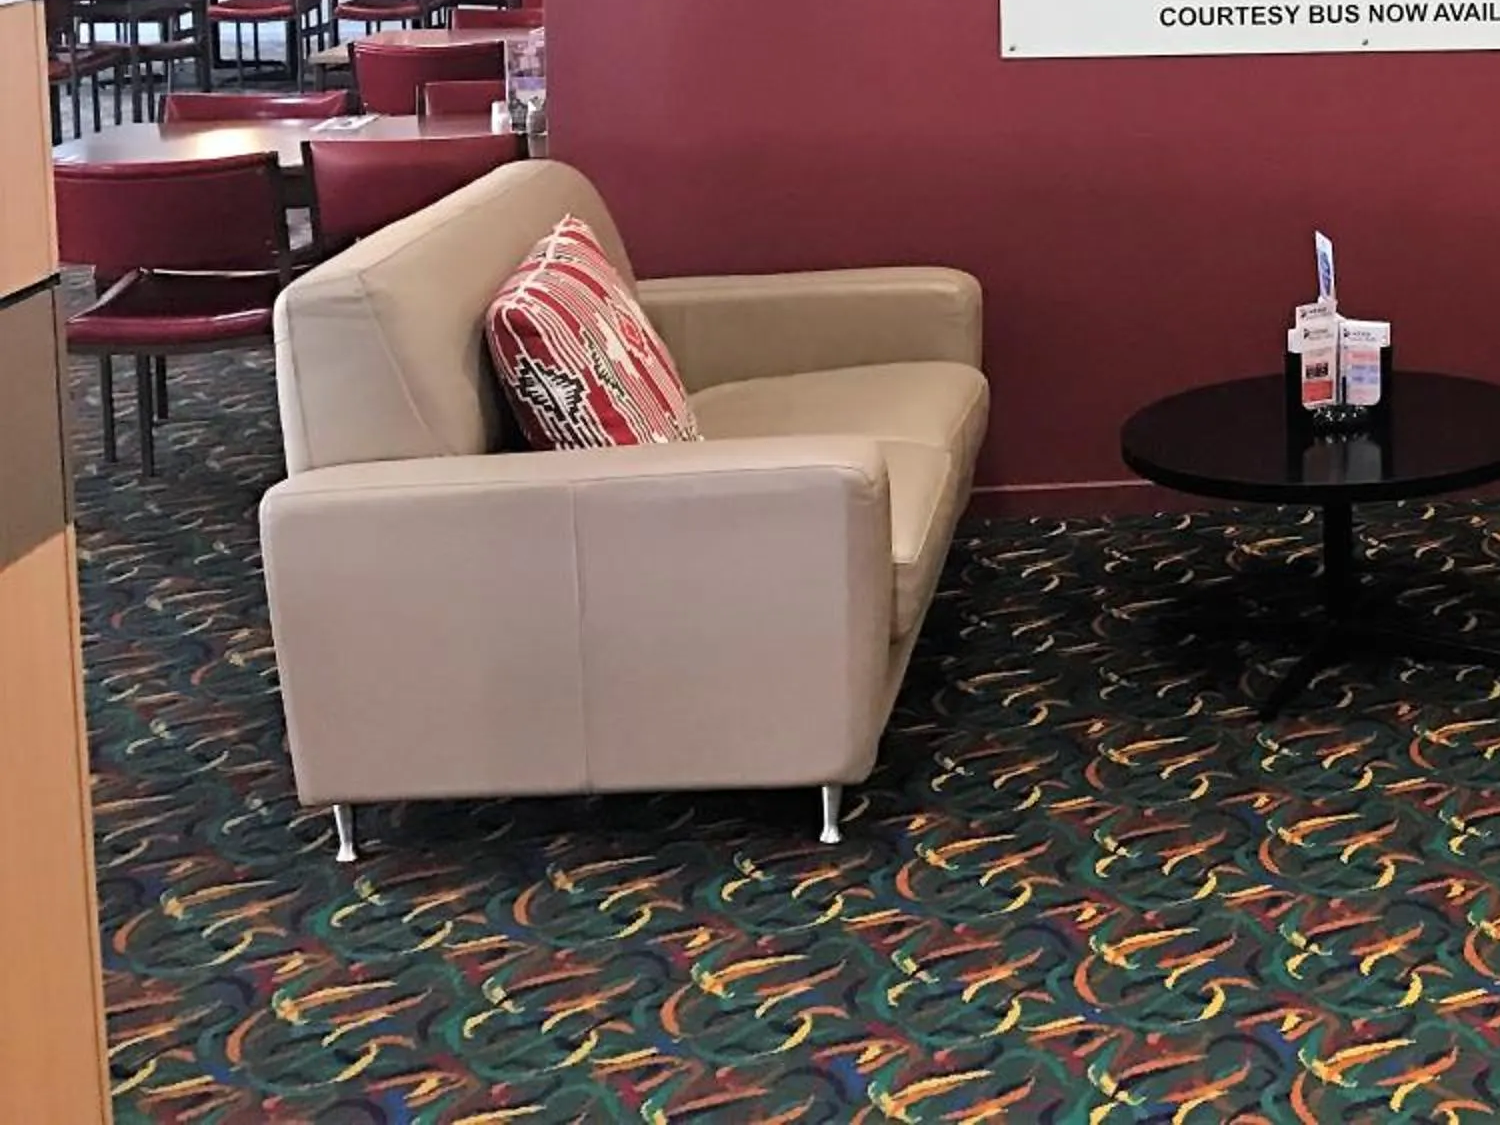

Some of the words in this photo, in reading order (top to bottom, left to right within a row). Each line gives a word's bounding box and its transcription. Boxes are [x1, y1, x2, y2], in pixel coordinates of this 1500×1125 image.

[1159, 6, 1300, 27] COURTESY
[1308, 4, 1360, 24] BUS
[1369, 3, 1429, 23] NOW
